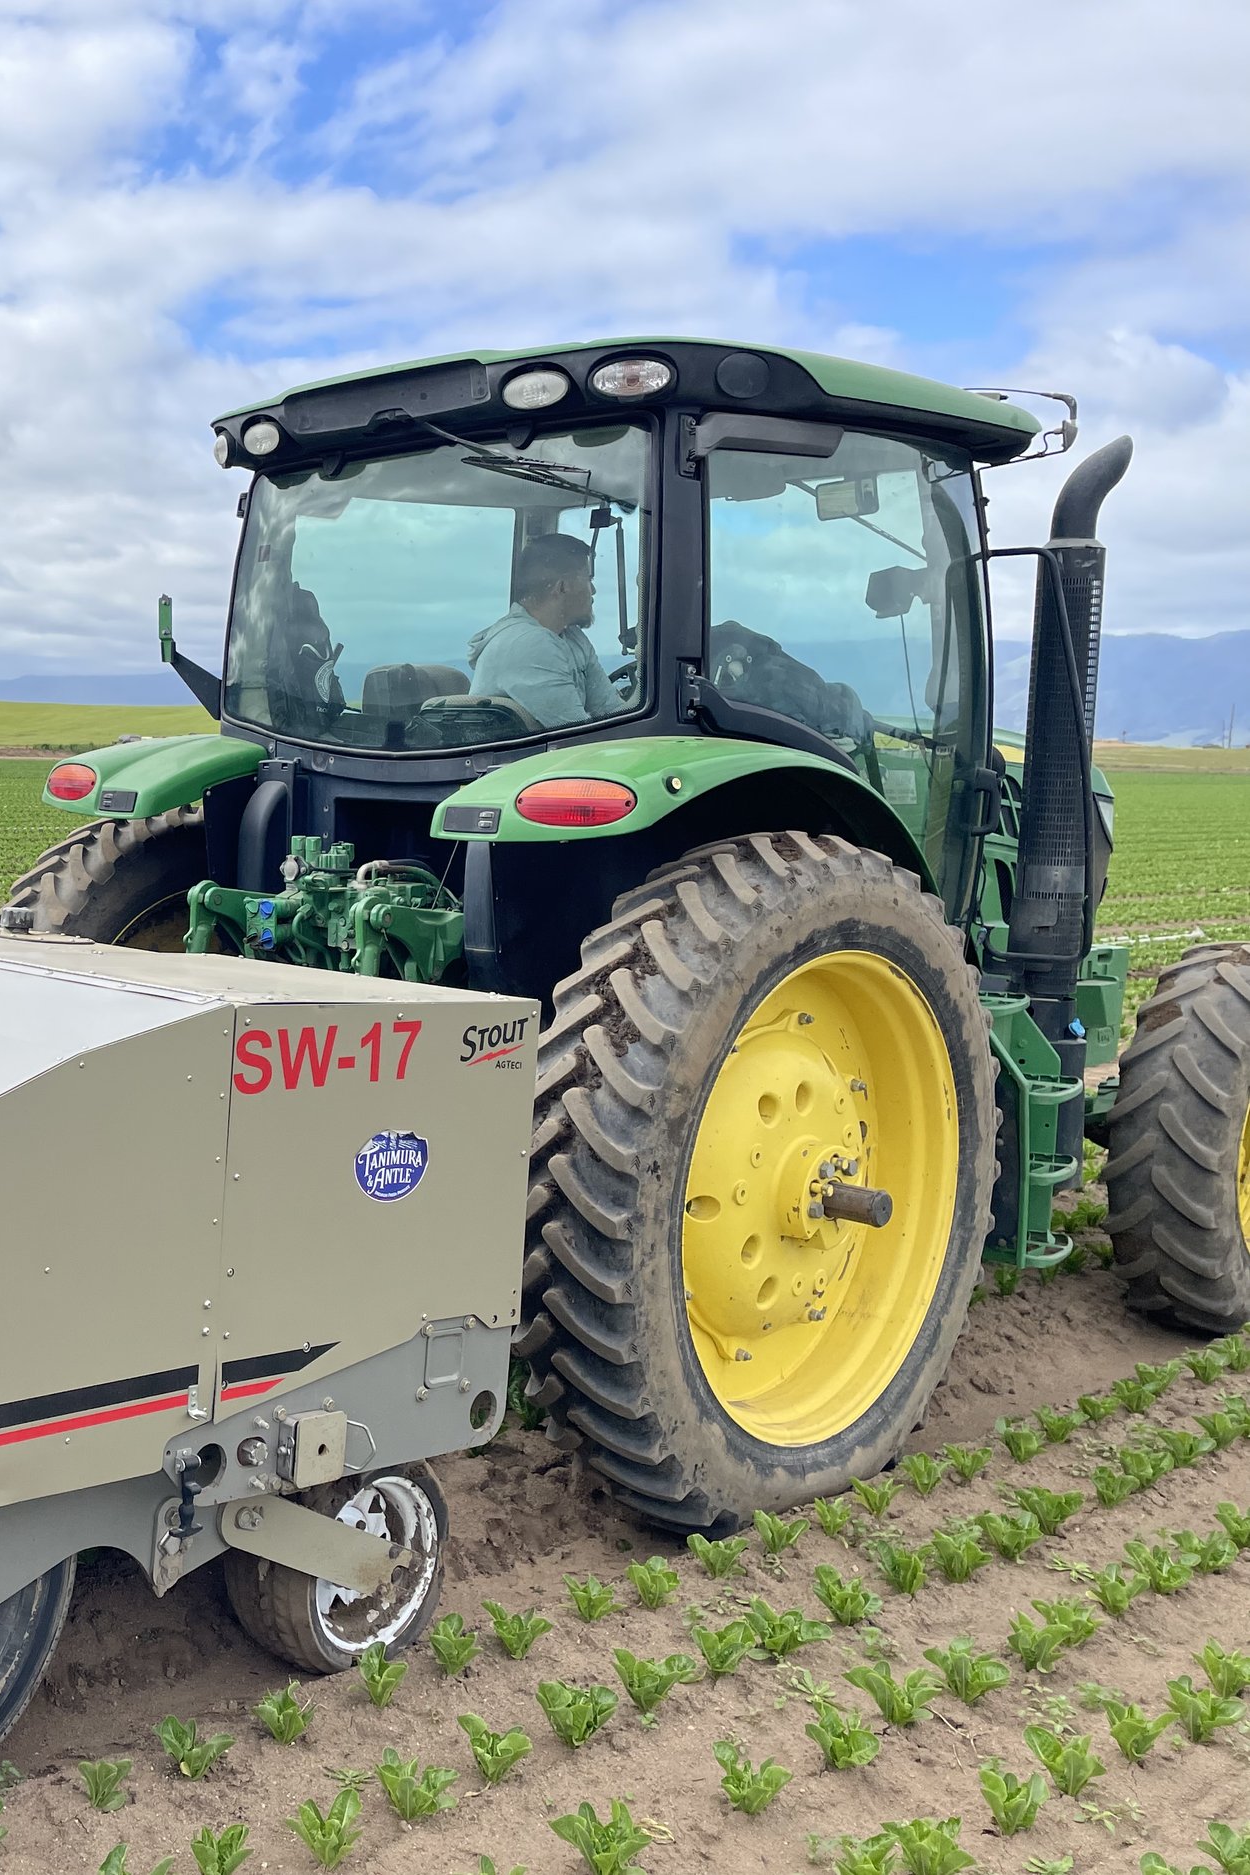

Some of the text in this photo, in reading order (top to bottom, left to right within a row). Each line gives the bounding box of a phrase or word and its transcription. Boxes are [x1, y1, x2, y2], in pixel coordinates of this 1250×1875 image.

[233, 1020, 422, 1095] SW-17
[460, 1017, 529, 1062] STOUT
[357, 1143, 423, 1177] TANIMURA
